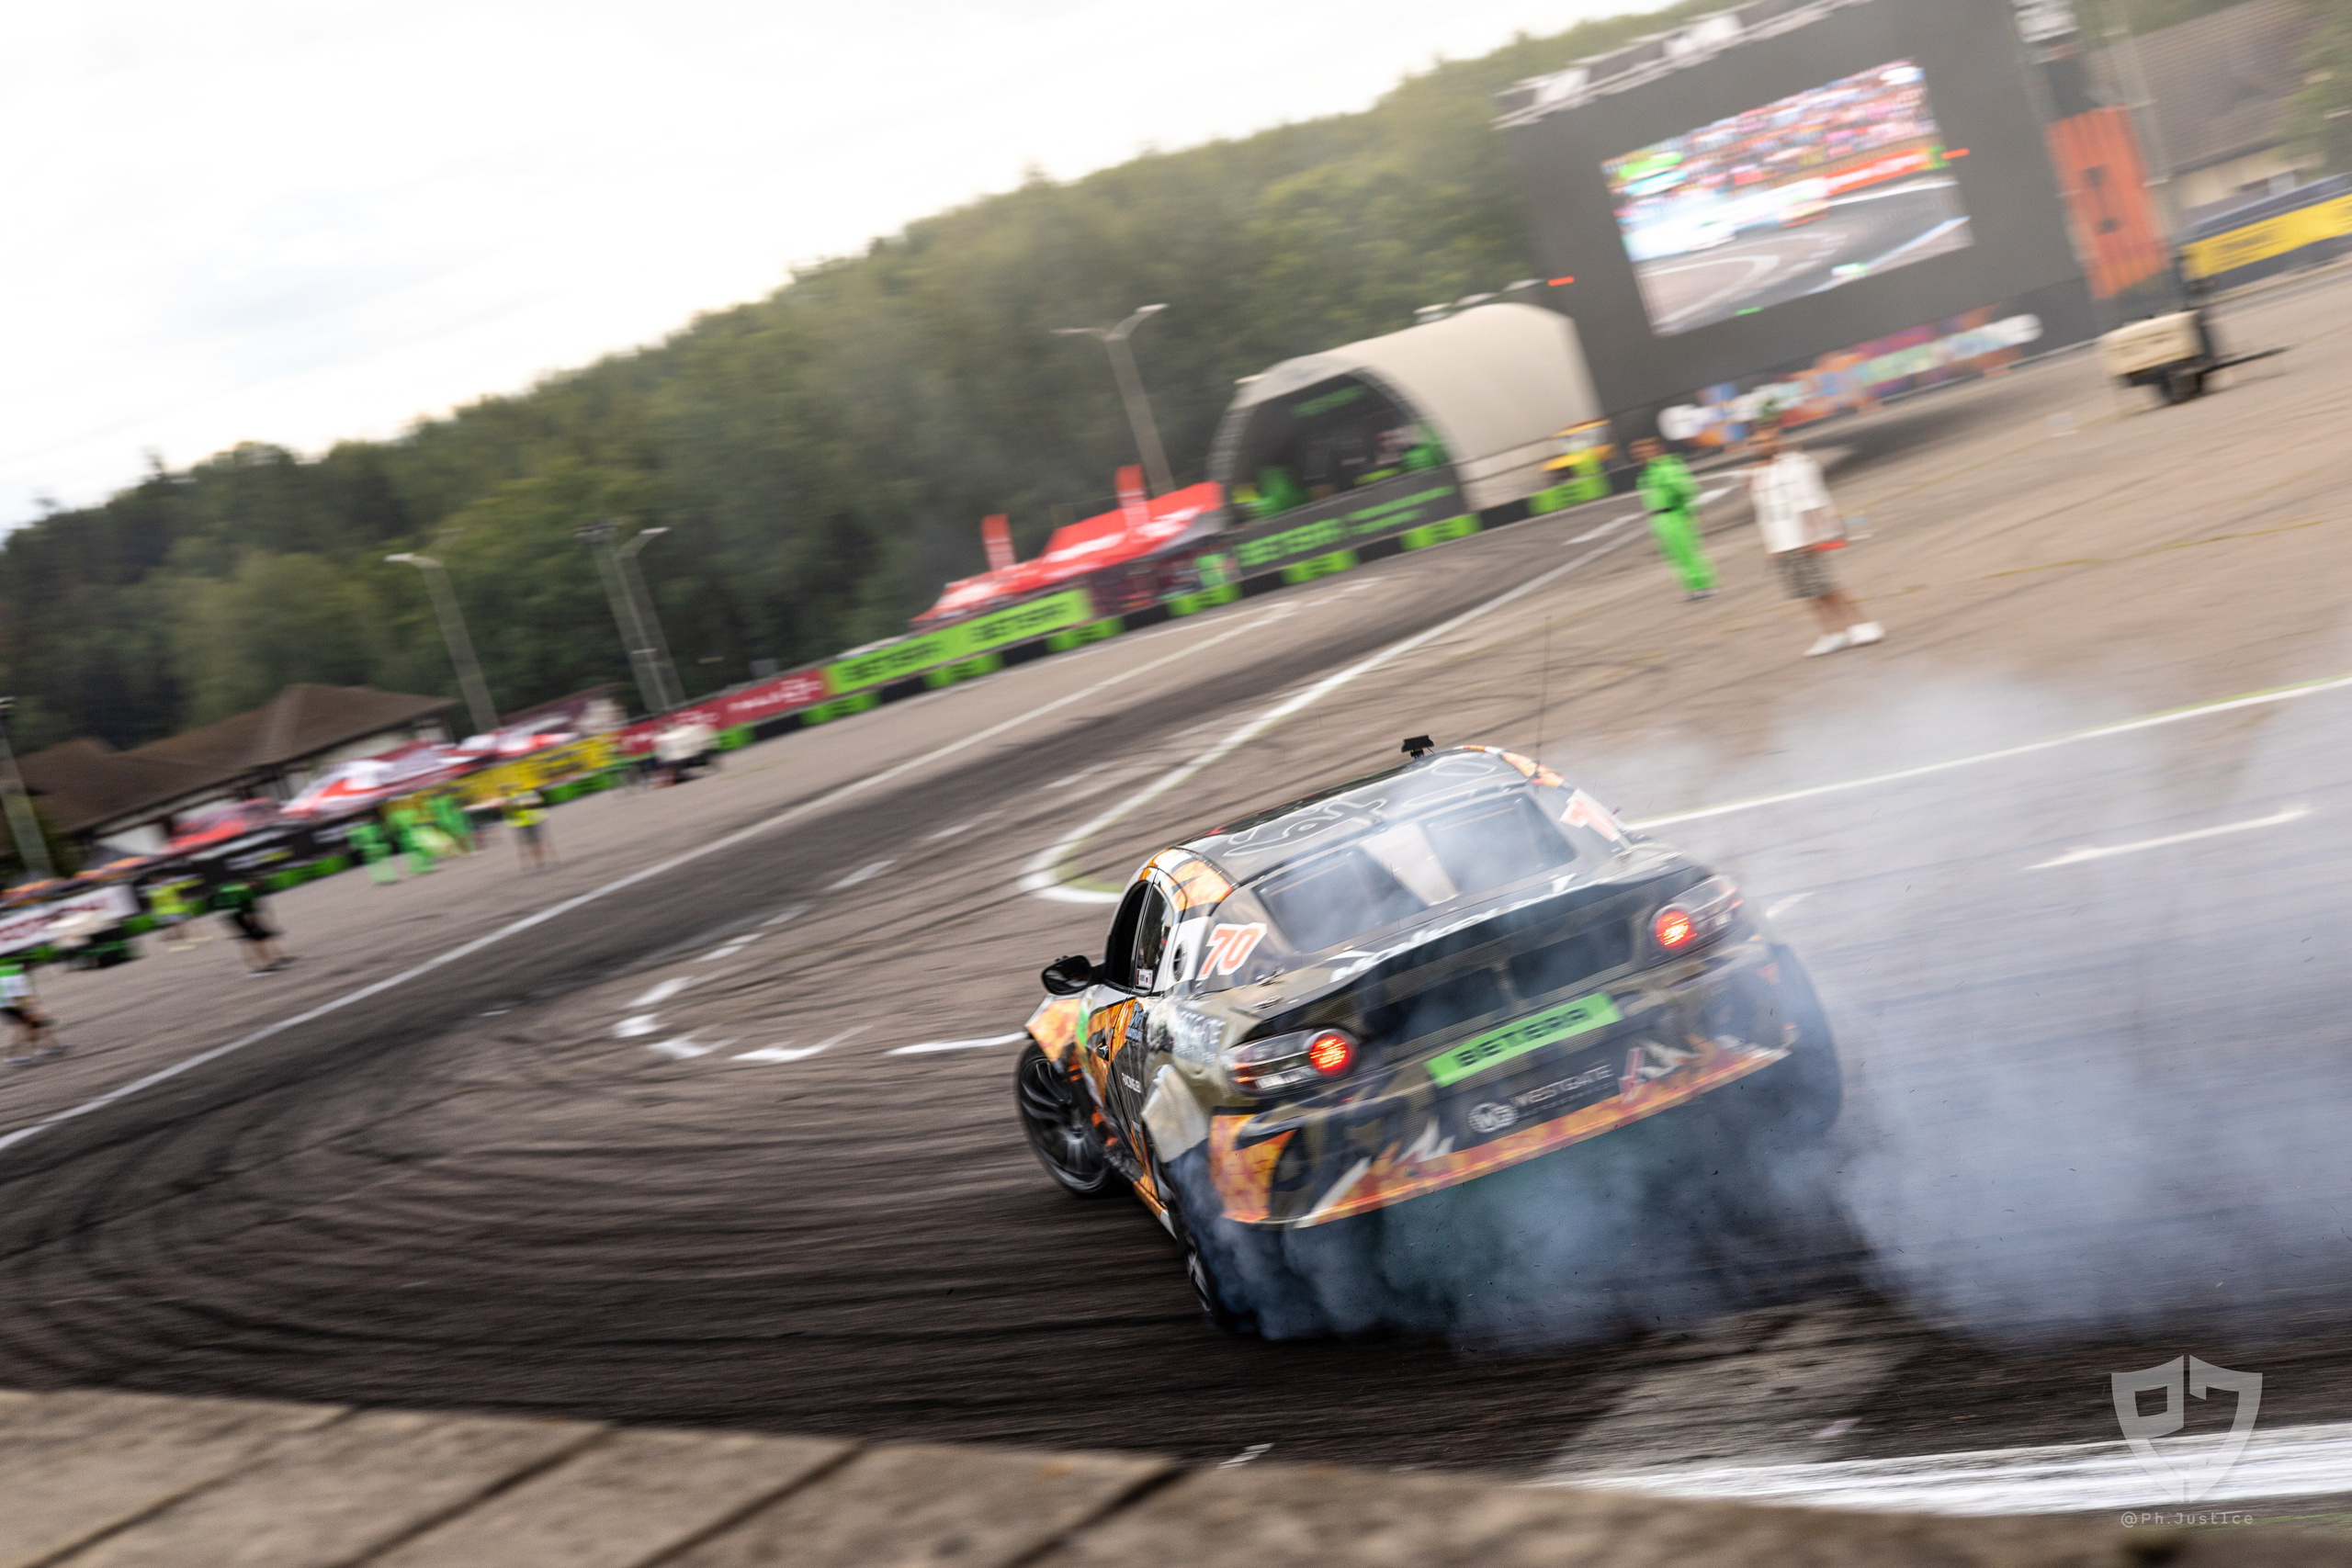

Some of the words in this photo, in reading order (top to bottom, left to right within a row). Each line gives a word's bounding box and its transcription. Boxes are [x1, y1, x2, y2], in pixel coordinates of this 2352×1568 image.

[1197, 921, 1268, 980] 70
[1453, 1007, 1591, 1067] BETERA
[1510, 1063, 1614, 1108] WESTGATE
